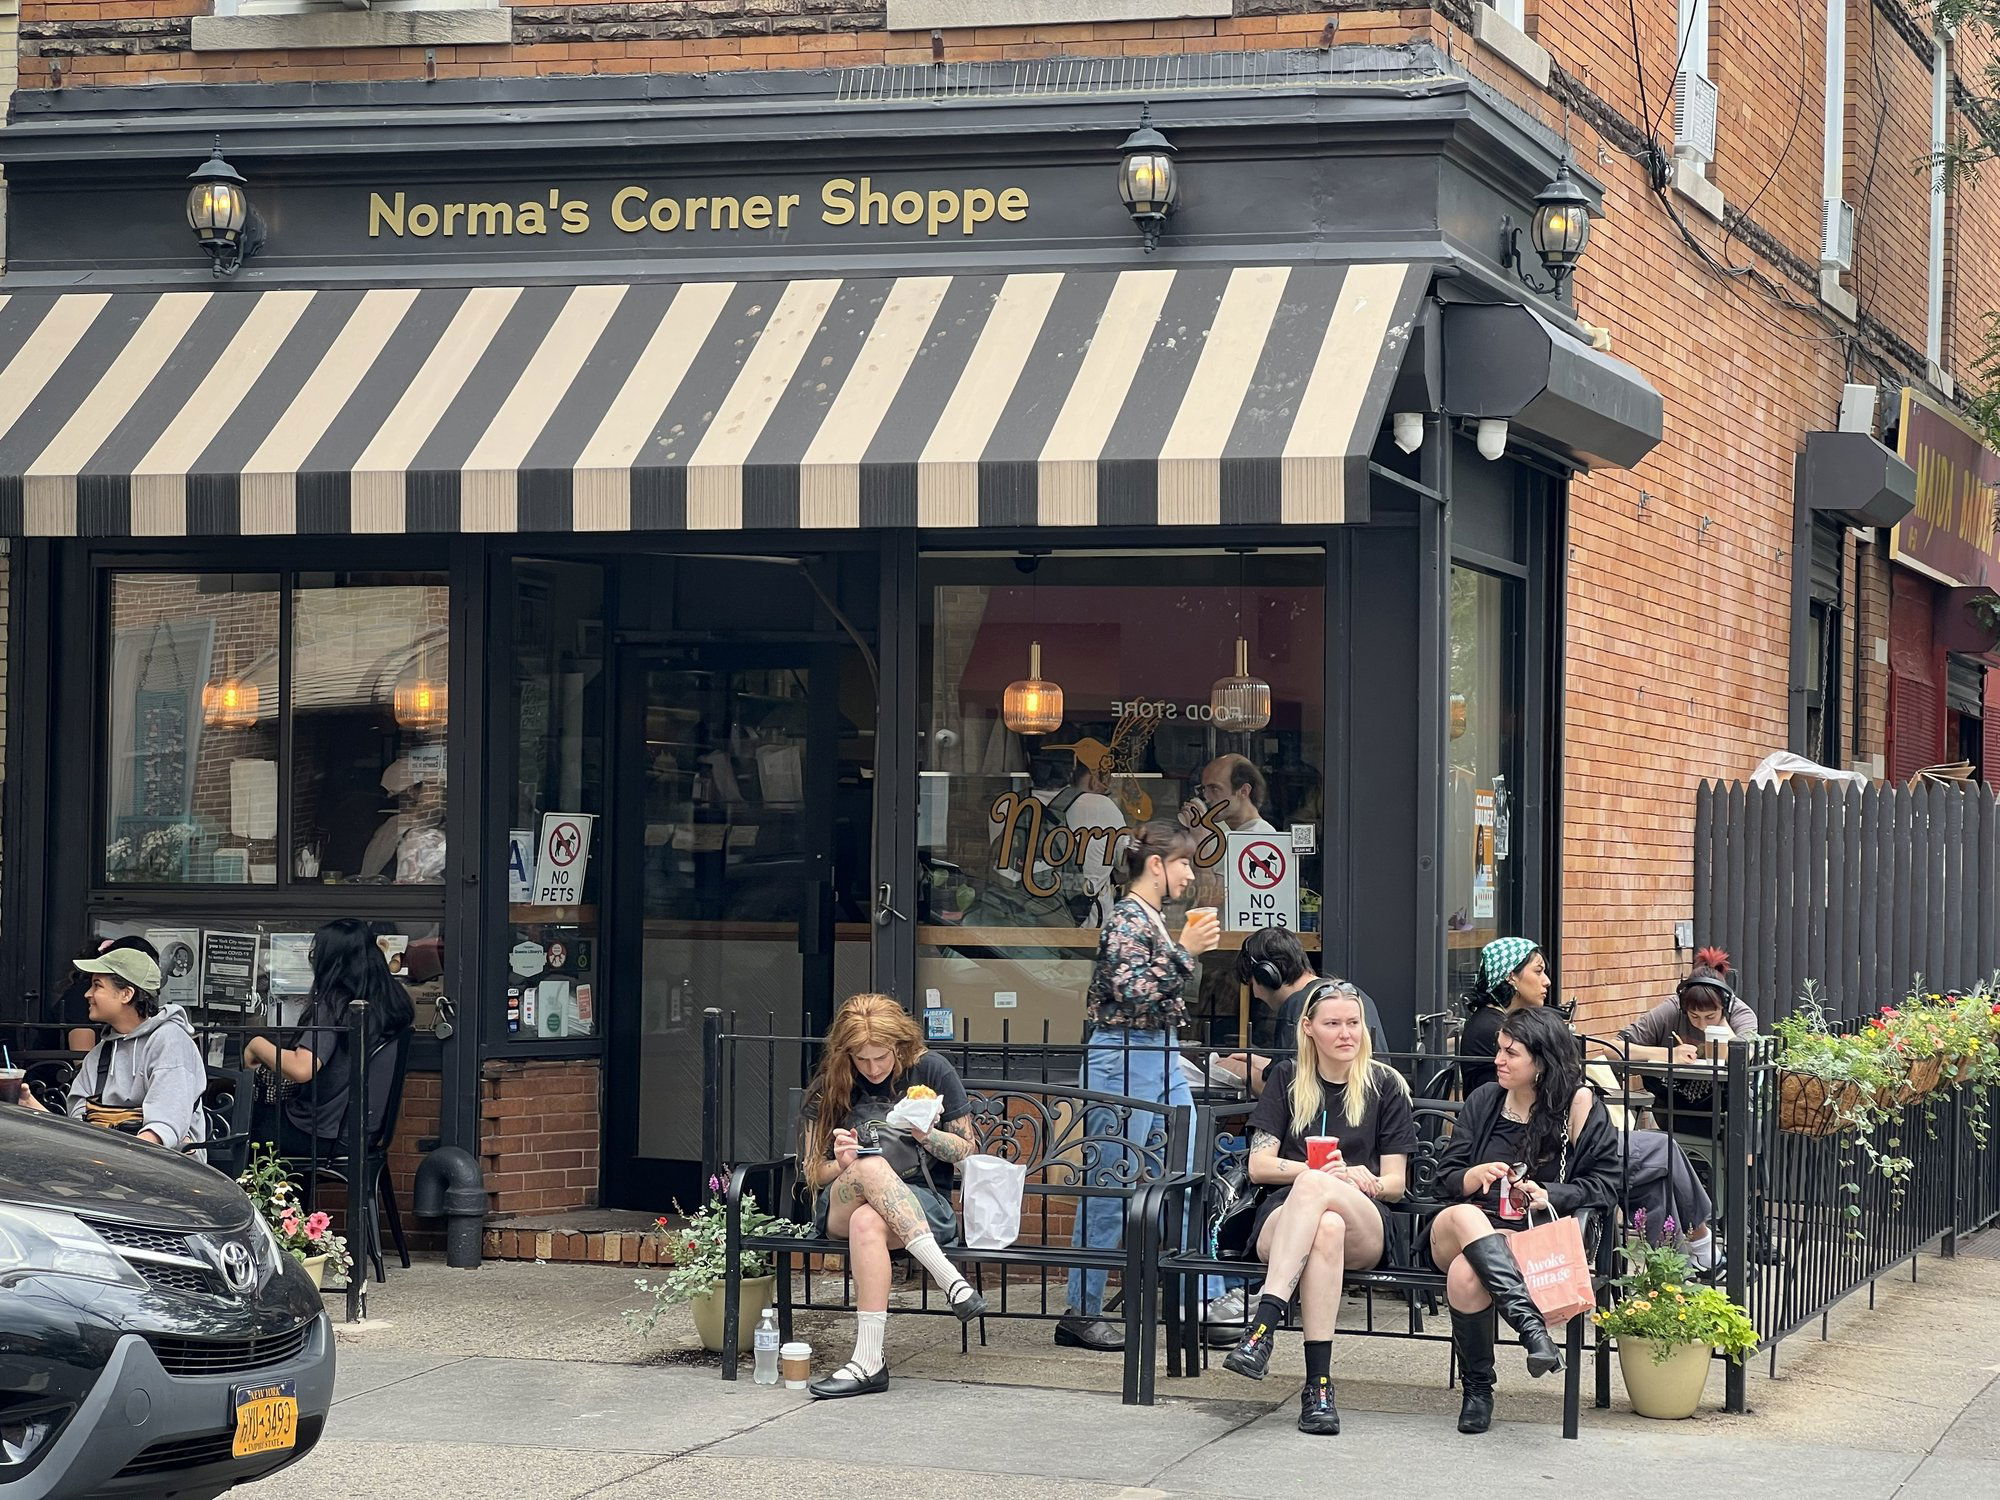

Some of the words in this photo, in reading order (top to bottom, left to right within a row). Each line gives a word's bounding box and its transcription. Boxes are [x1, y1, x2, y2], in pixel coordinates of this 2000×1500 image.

[369, 188, 591, 237] Norma's
[611, 186, 800, 233] Corner
[821, 177, 1030, 236] Shoppe
[991, 791, 1229, 898] Nor's
[509, 840, 526, 882] A
[551, 870, 569, 885] NO
[540, 888, 574, 902] PETS
[1250, 893, 1275, 909] NO
[1239, 911, 1288, 928] PETS
[1525, 1253, 1566, 1275] Awoke
[250, 1388, 264, 1401] NEW
[265, 1386, 281, 1398] YORK
[264, 1401, 291, 1438] 3493
